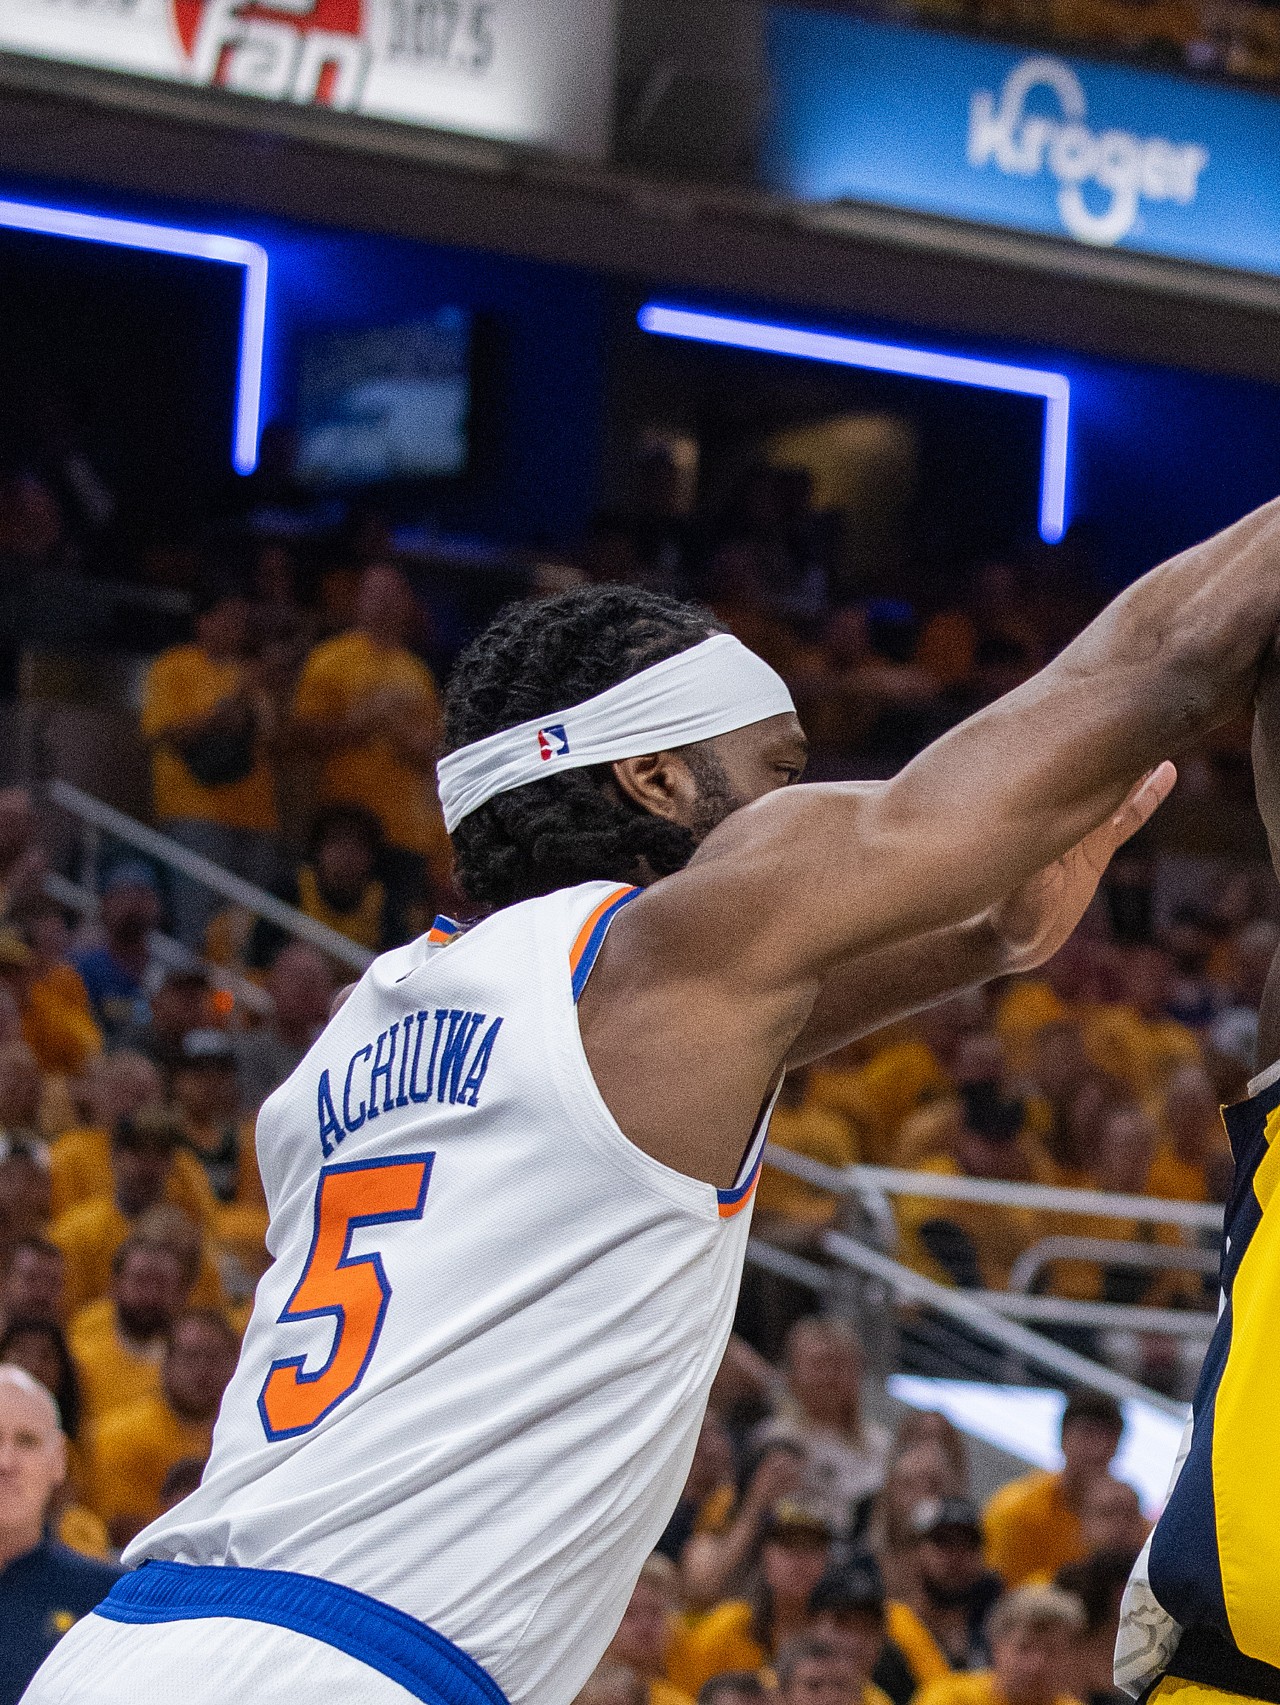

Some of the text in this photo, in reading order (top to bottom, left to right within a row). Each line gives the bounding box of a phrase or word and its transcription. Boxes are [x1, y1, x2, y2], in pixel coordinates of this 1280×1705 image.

[967, 54, 1211, 247] Kroger
[318, 1008, 504, 1158] ACHIUWA
[257, 1151, 437, 1443] 5
